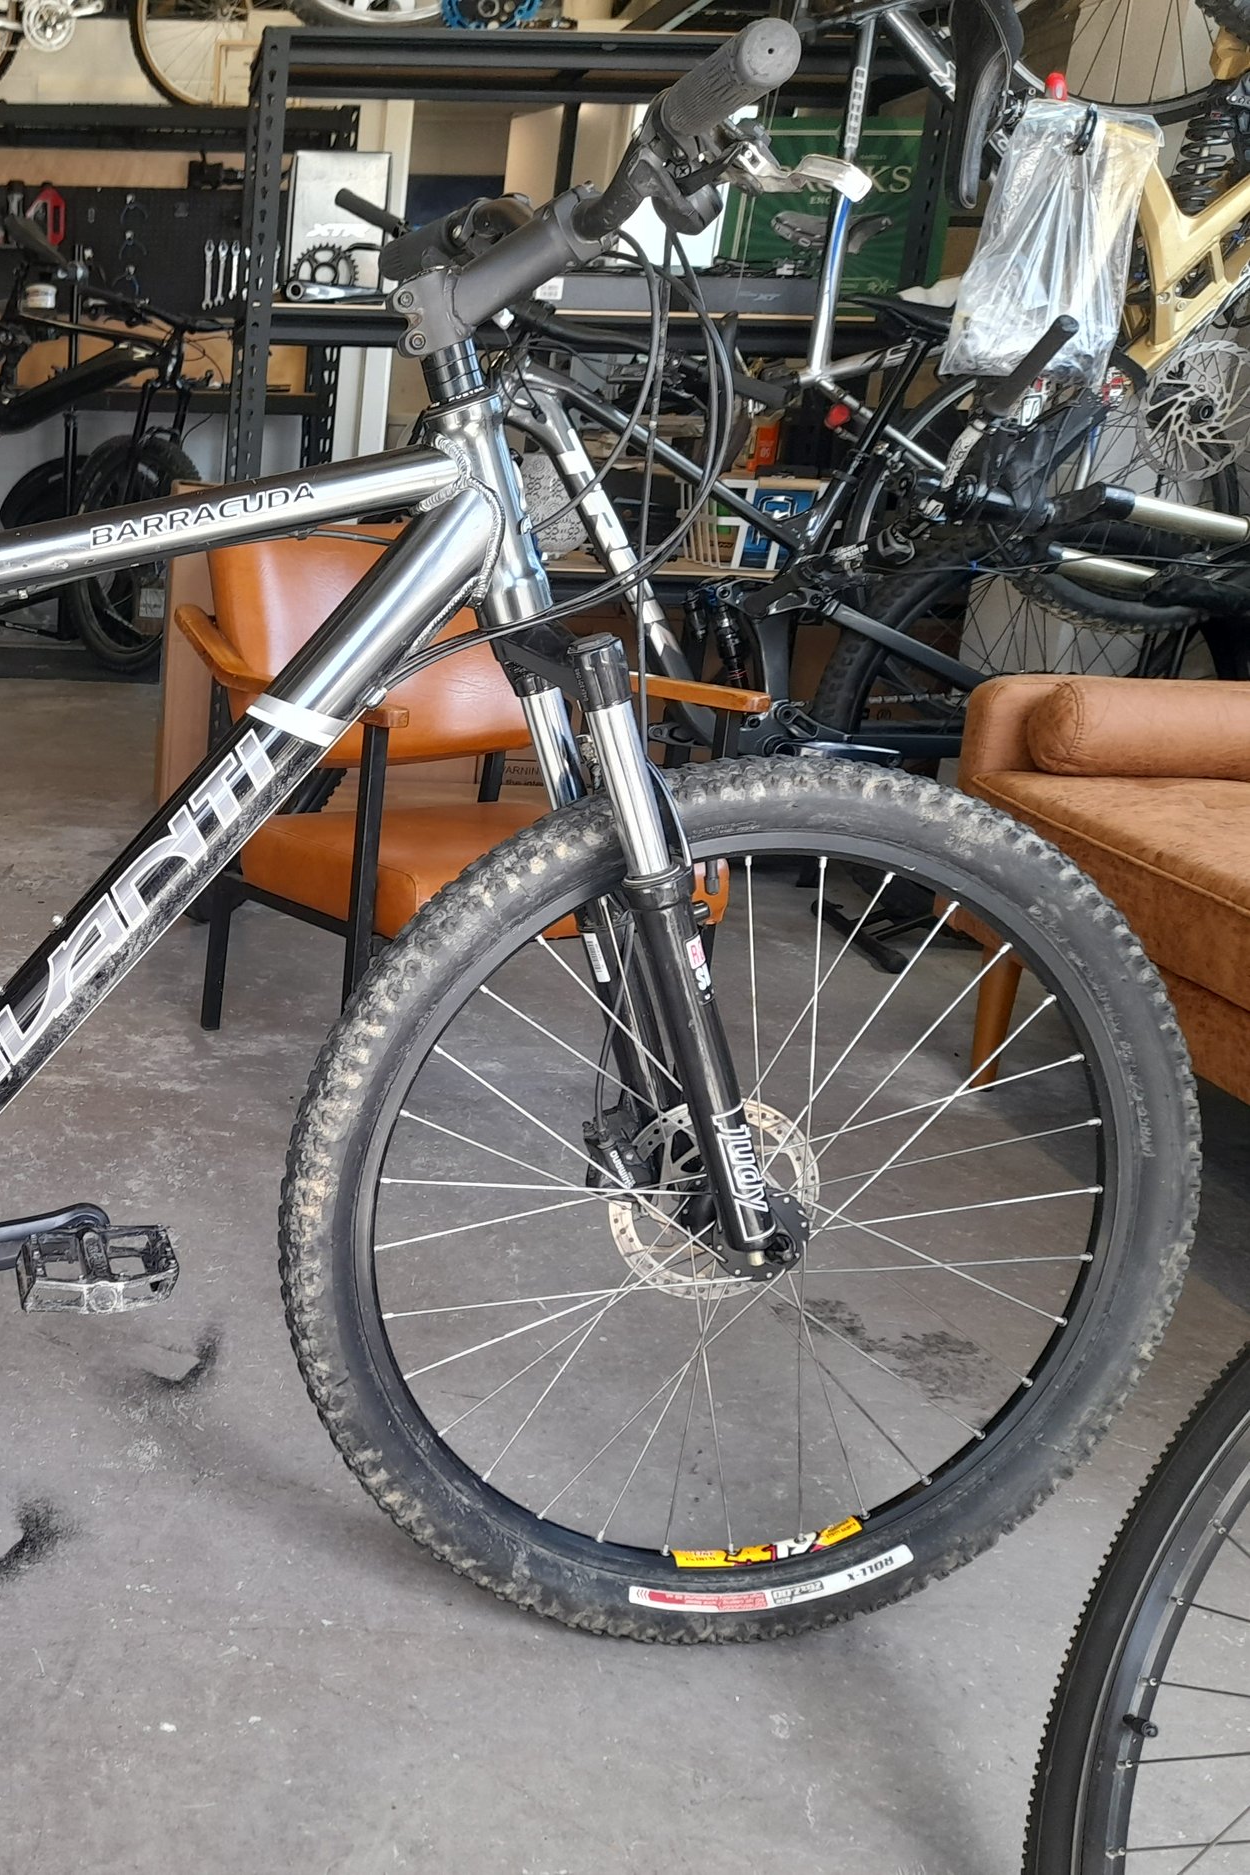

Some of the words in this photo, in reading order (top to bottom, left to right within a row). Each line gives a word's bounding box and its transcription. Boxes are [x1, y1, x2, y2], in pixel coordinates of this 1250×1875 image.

[90, 482, 315, 548] BARRACUDA
[505, 765, 540, 776] ARNIN
[847, 1556, 894, 1582] ROLL-X
